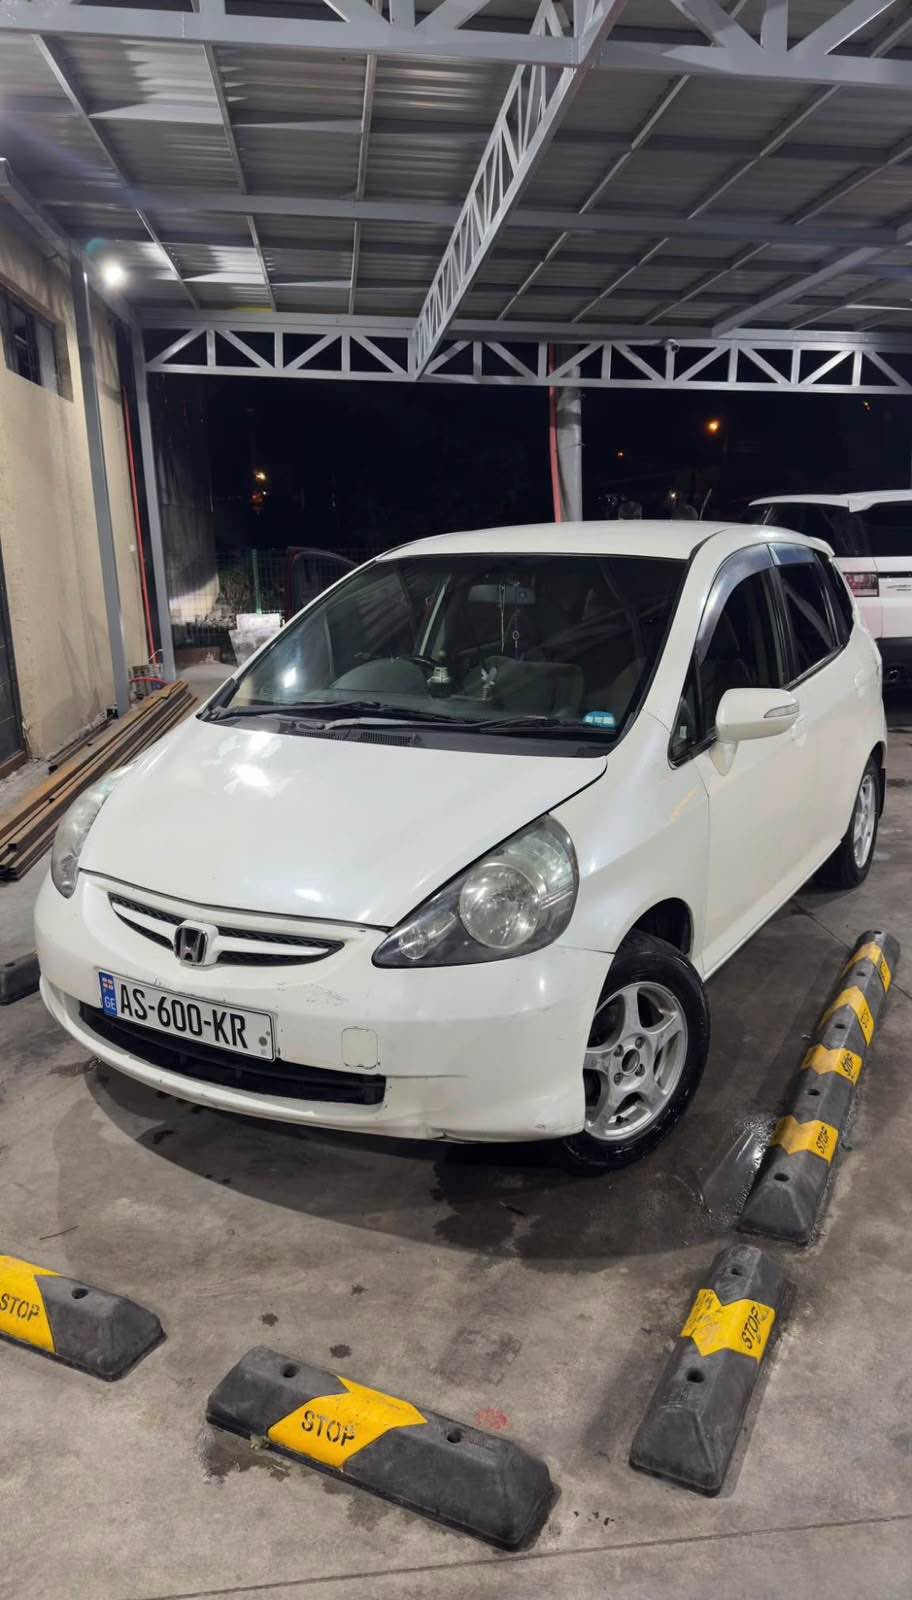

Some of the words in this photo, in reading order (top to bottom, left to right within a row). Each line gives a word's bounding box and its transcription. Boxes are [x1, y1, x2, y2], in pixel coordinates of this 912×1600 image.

[104, 995, 117, 1010] GE
[120, 983, 248, 1049] AS-600-KR
[0, 1293, 41, 1322] STOP
[741, 1306, 761, 1349] STOP
[301, 1410, 355, 1446] STOP
